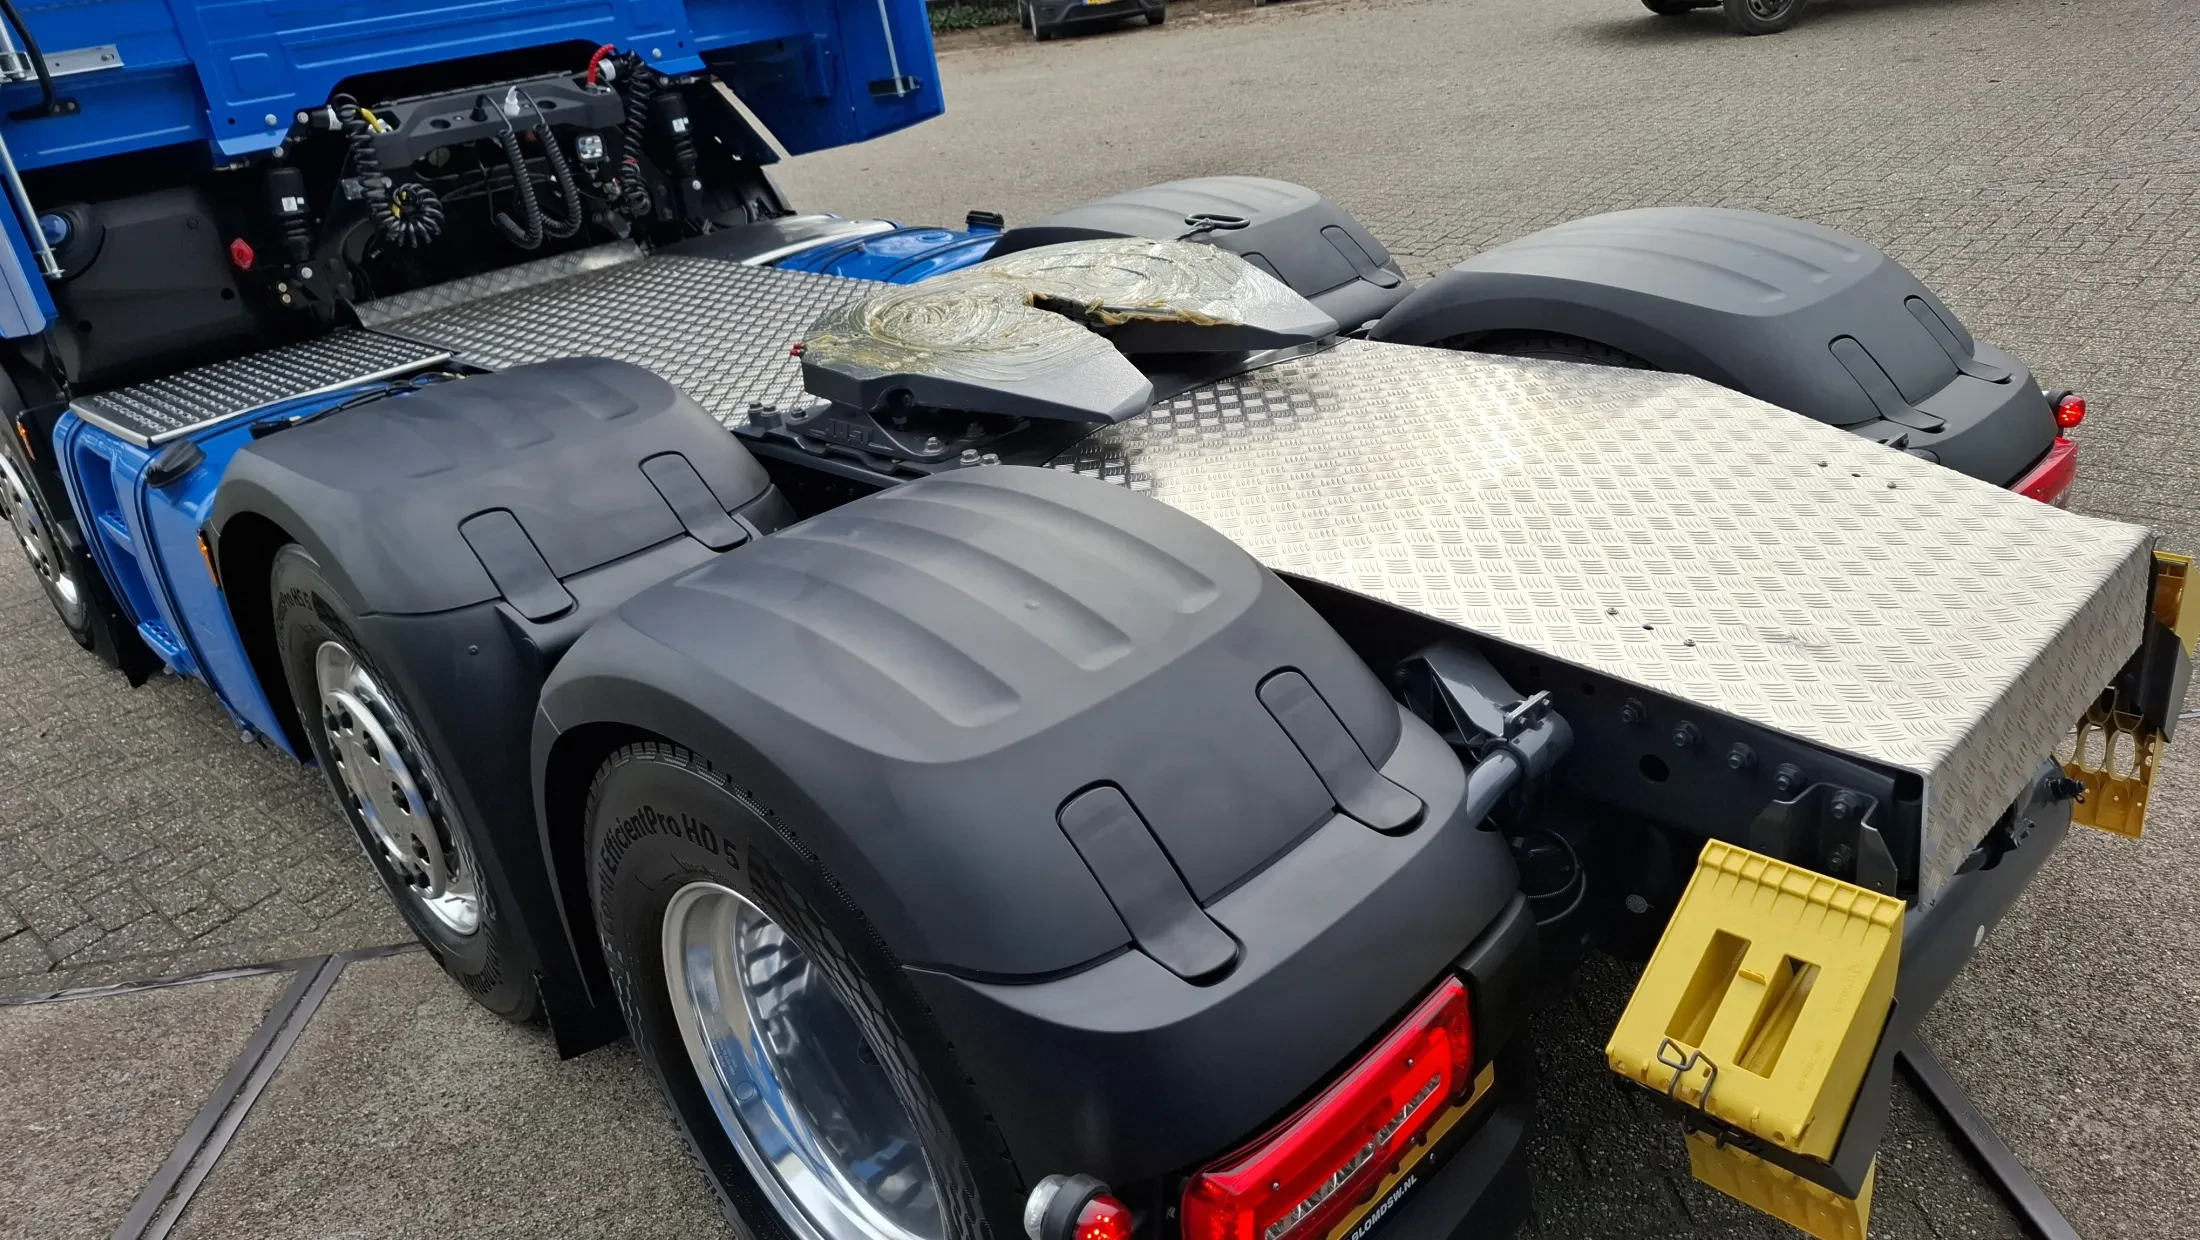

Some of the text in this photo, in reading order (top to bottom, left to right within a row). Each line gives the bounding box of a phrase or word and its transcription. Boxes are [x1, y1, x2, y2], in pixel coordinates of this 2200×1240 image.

[600, 804, 682, 876] EfficientPro
[681, 813, 720, 855] HD
[723, 838, 741, 871] 5
[1347, 1174, 1418, 1240] BLOMDSW.NL
